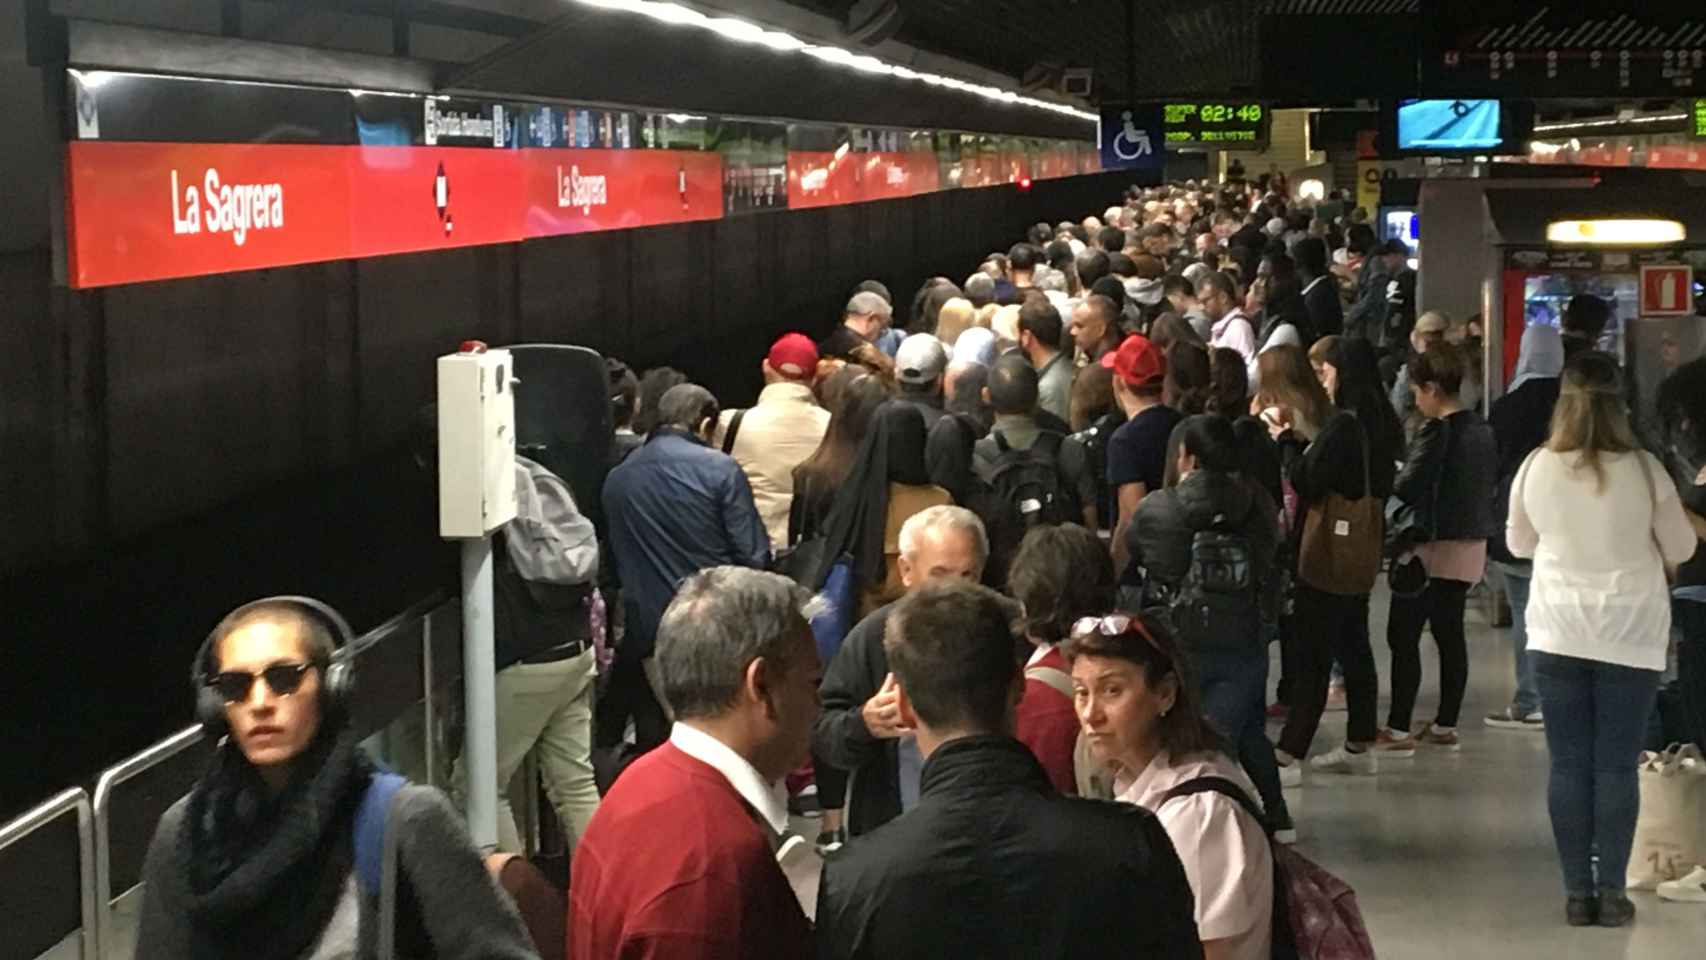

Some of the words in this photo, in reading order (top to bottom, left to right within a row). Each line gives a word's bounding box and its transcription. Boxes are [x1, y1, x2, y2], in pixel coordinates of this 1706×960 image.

[1201, 104, 1262, 122] 02:40
[171, 169, 200, 234] La
[204, 168, 283, 246] Sagrera
[557, 165, 570, 207] La
[571, 165, 607, 216] Sagrera
